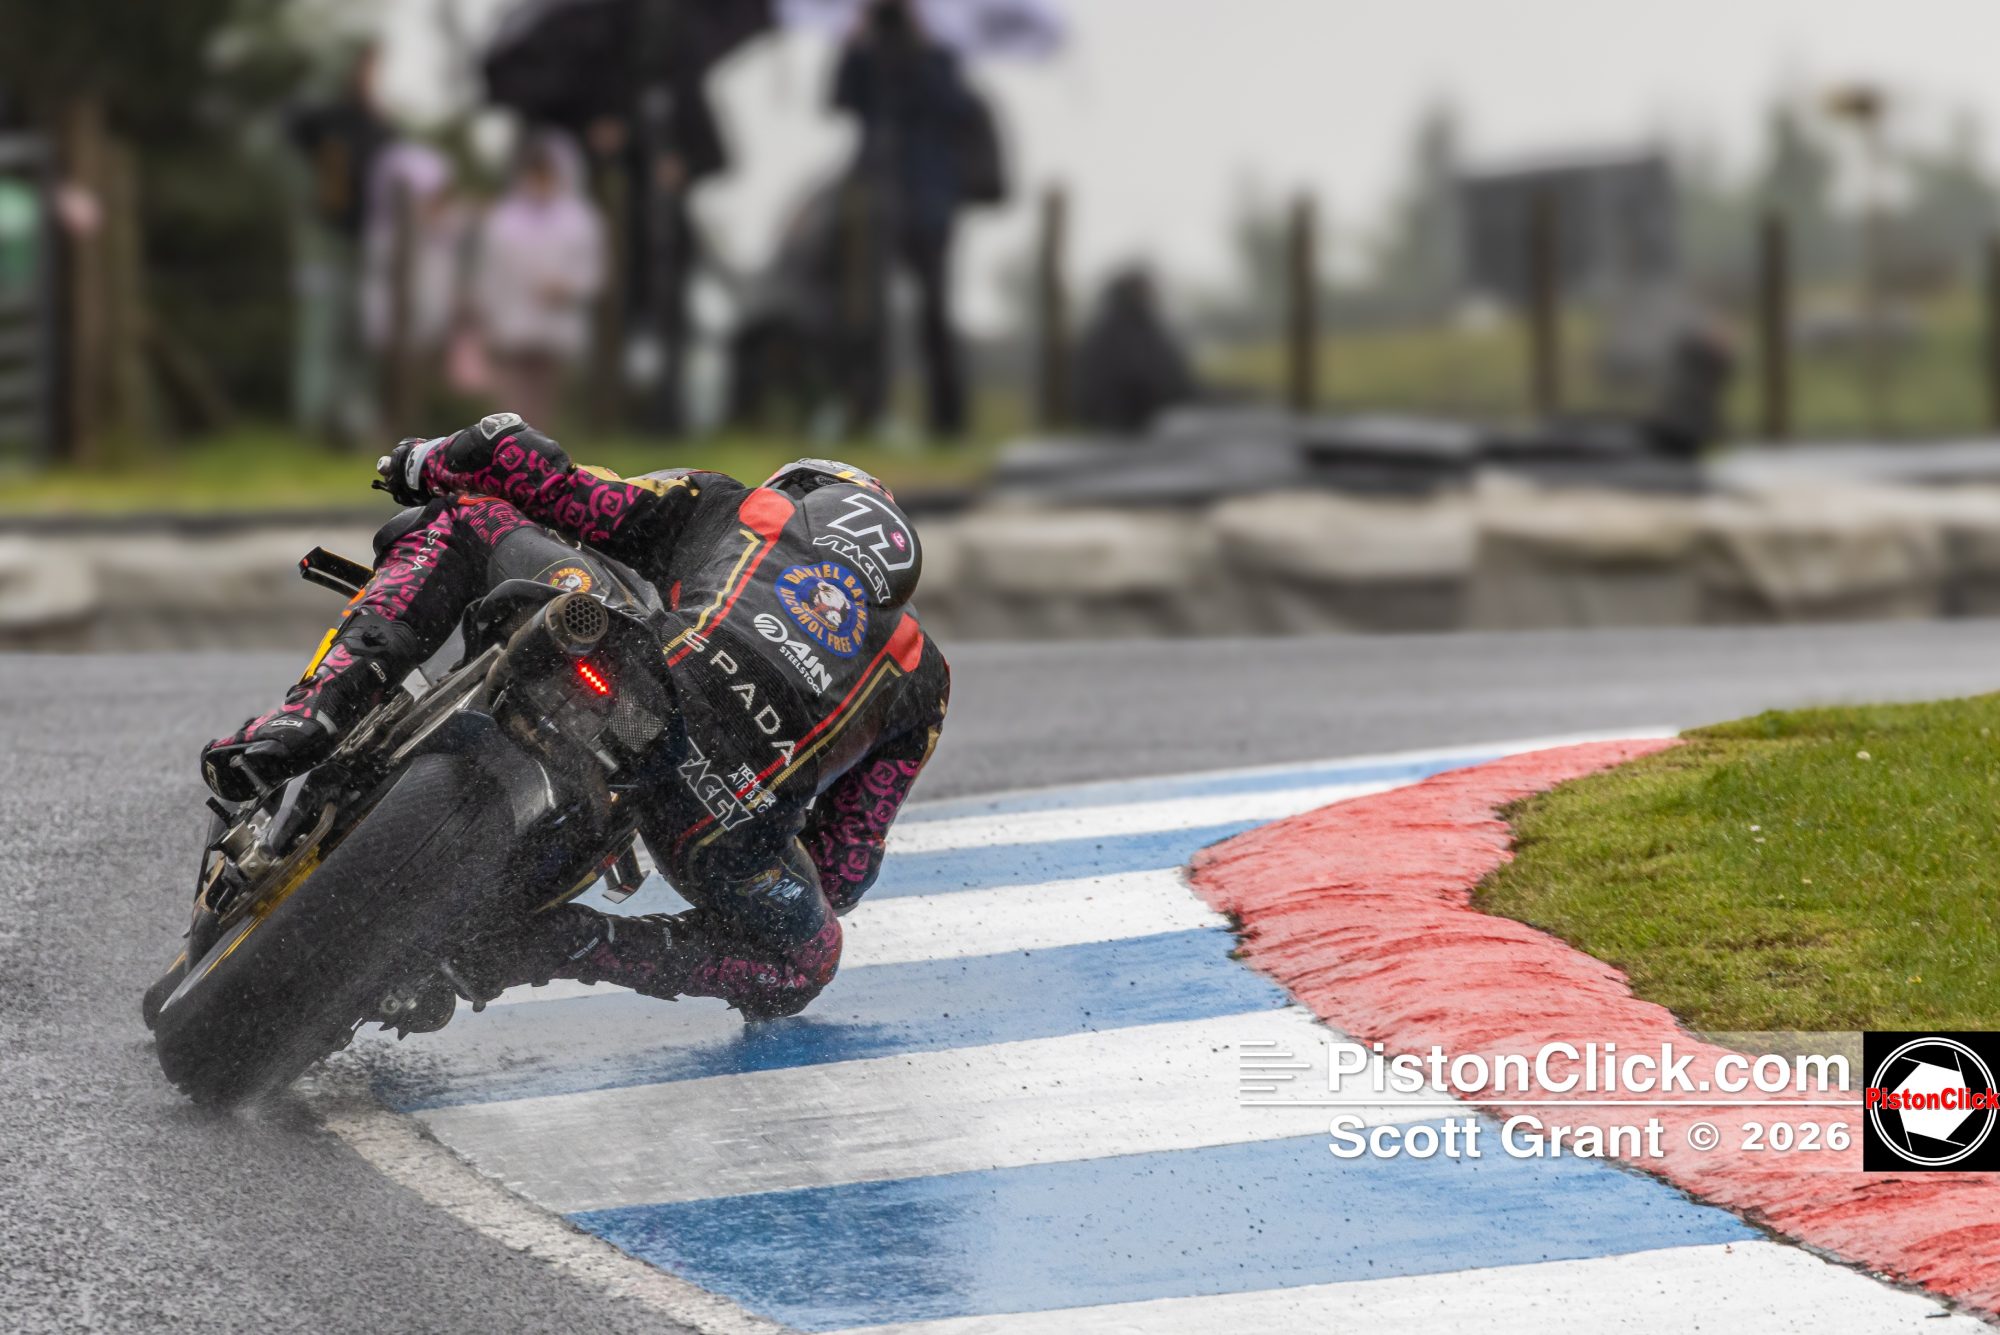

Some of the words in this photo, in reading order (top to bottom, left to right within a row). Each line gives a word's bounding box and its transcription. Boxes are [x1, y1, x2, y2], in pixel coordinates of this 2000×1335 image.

[784, 564, 840, 584] DANIEL
[812, 534, 891, 604] STACEY
[780, 587, 823, 640] ALCOHOL
[828, 633, 852, 653] FREE
[779, 645, 823, 697] STEELSTOCK
[784, 640, 833, 691] AJN
[682, 631, 796, 767] SPADA
[678, 736, 754, 831] TACEY
